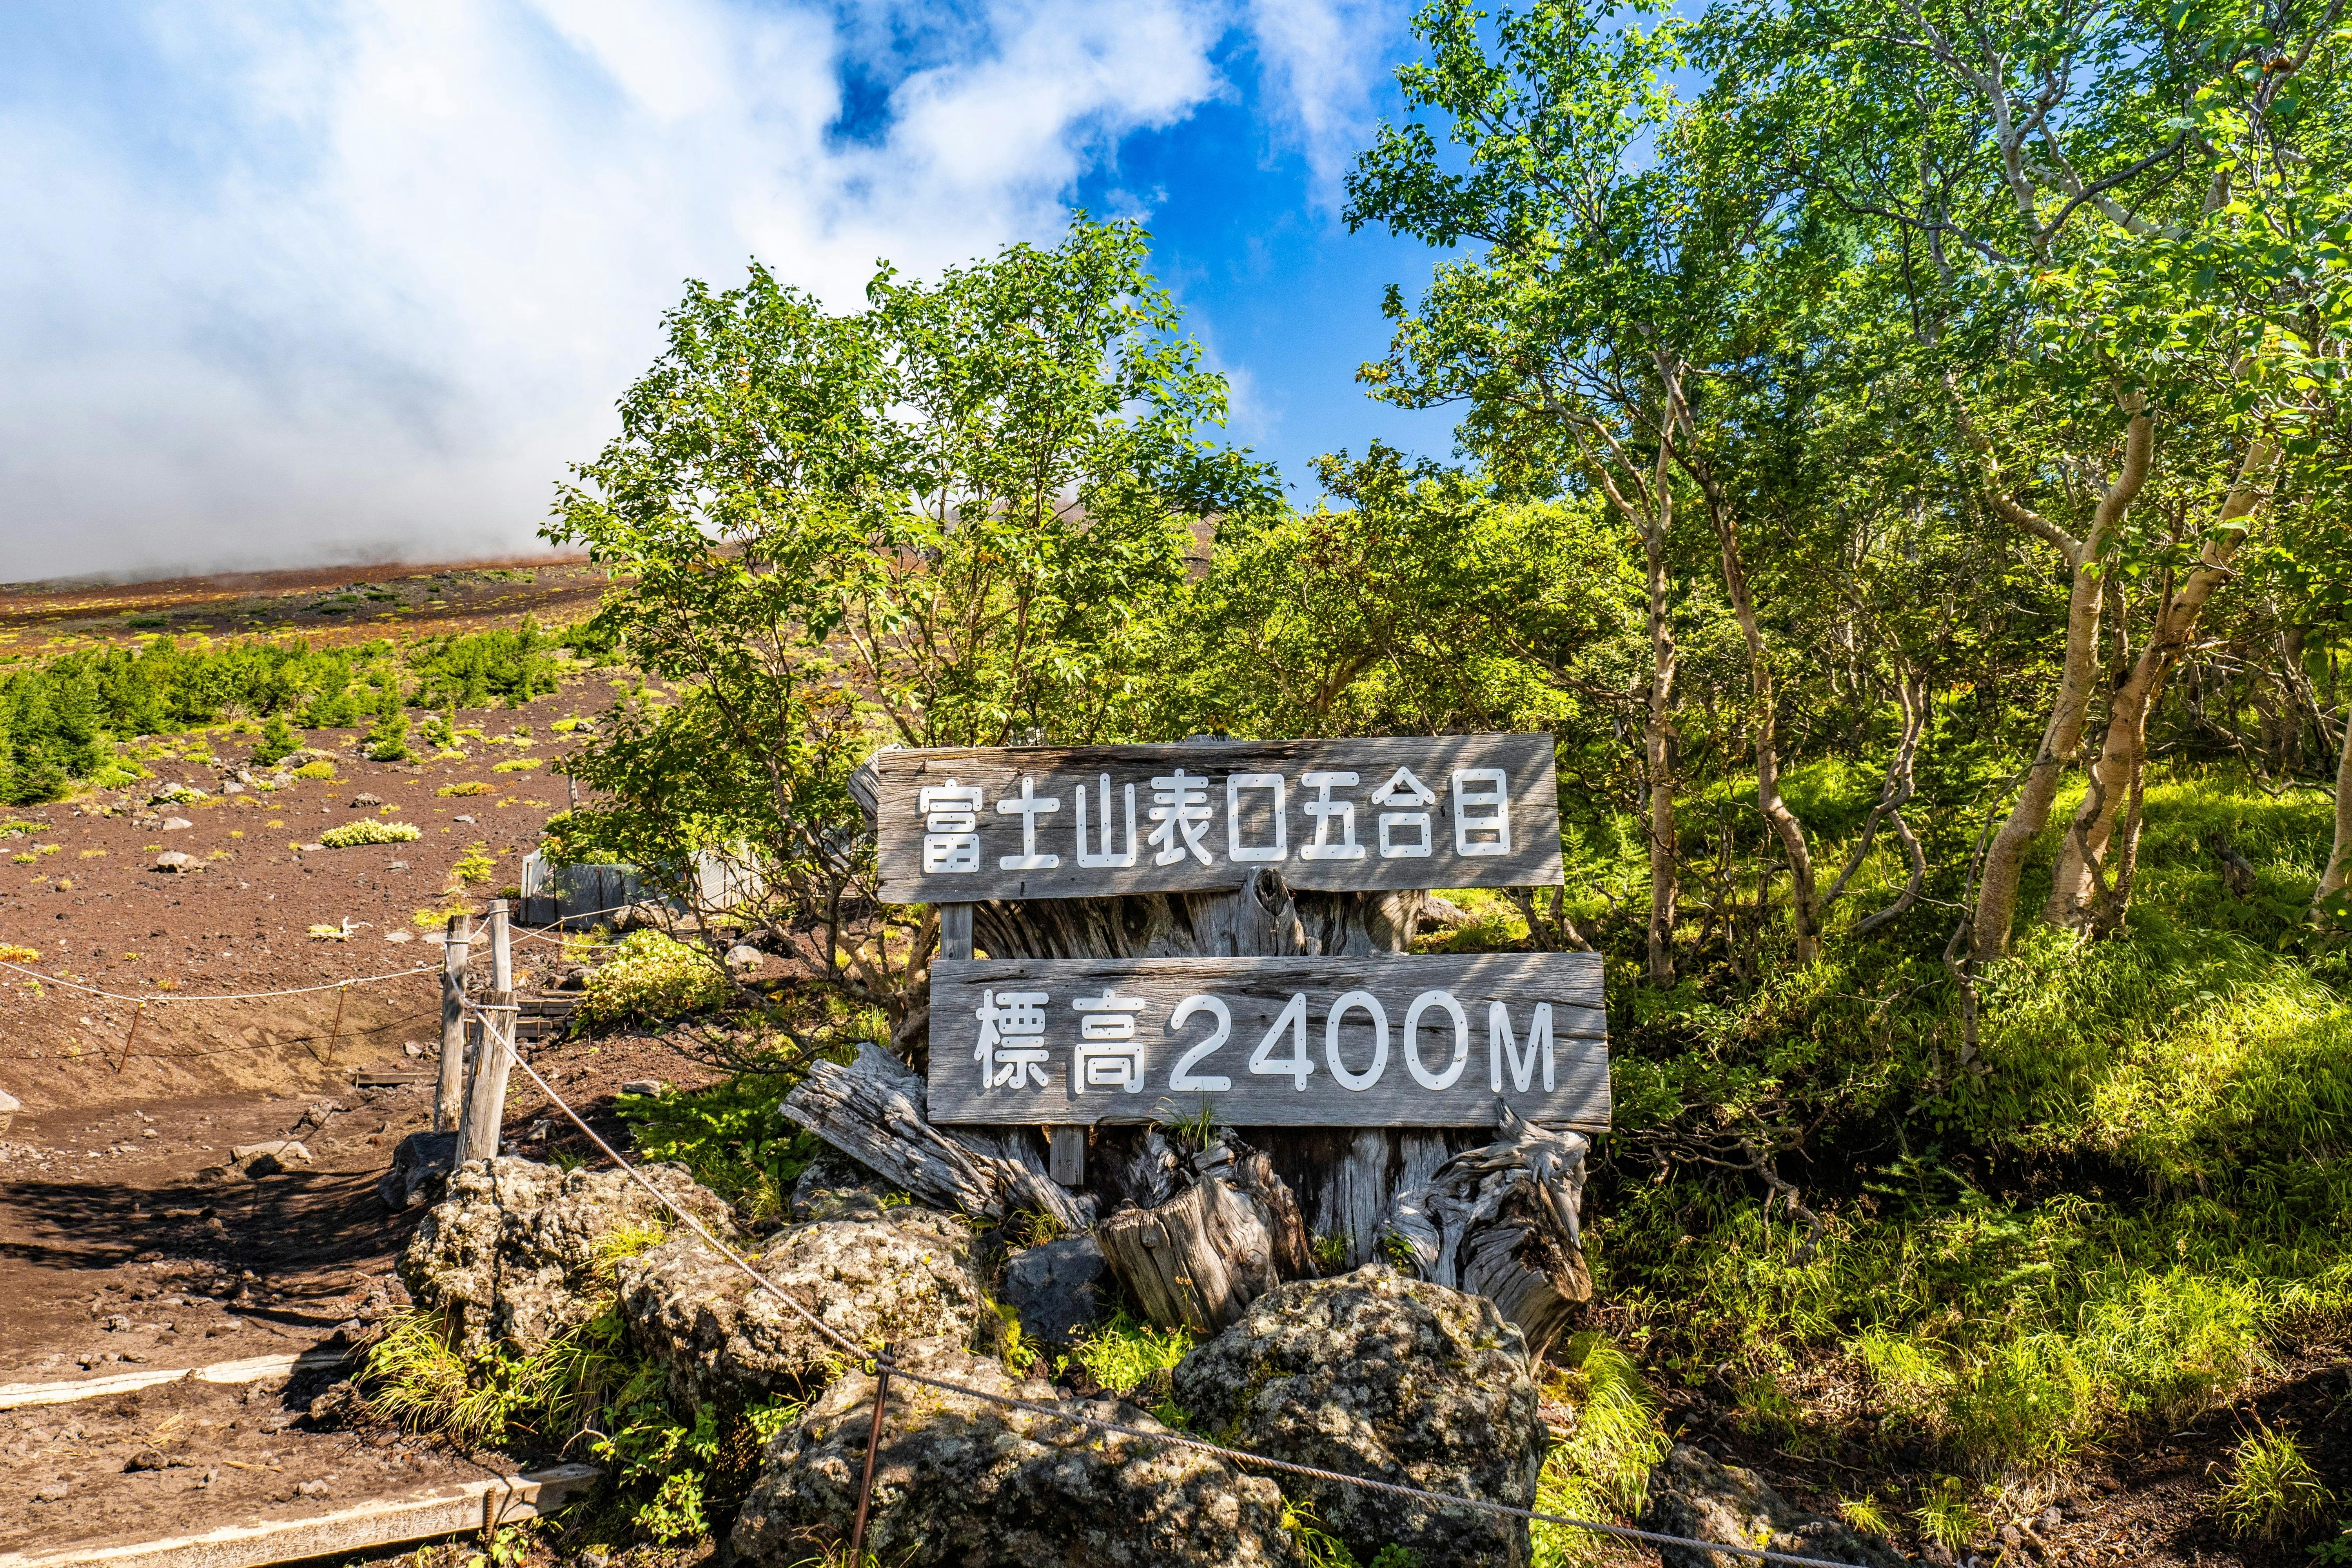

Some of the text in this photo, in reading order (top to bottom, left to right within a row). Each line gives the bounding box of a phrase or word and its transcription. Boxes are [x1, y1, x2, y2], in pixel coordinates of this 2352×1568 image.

[919, 766, 1511, 874] 富士山表口五合目
